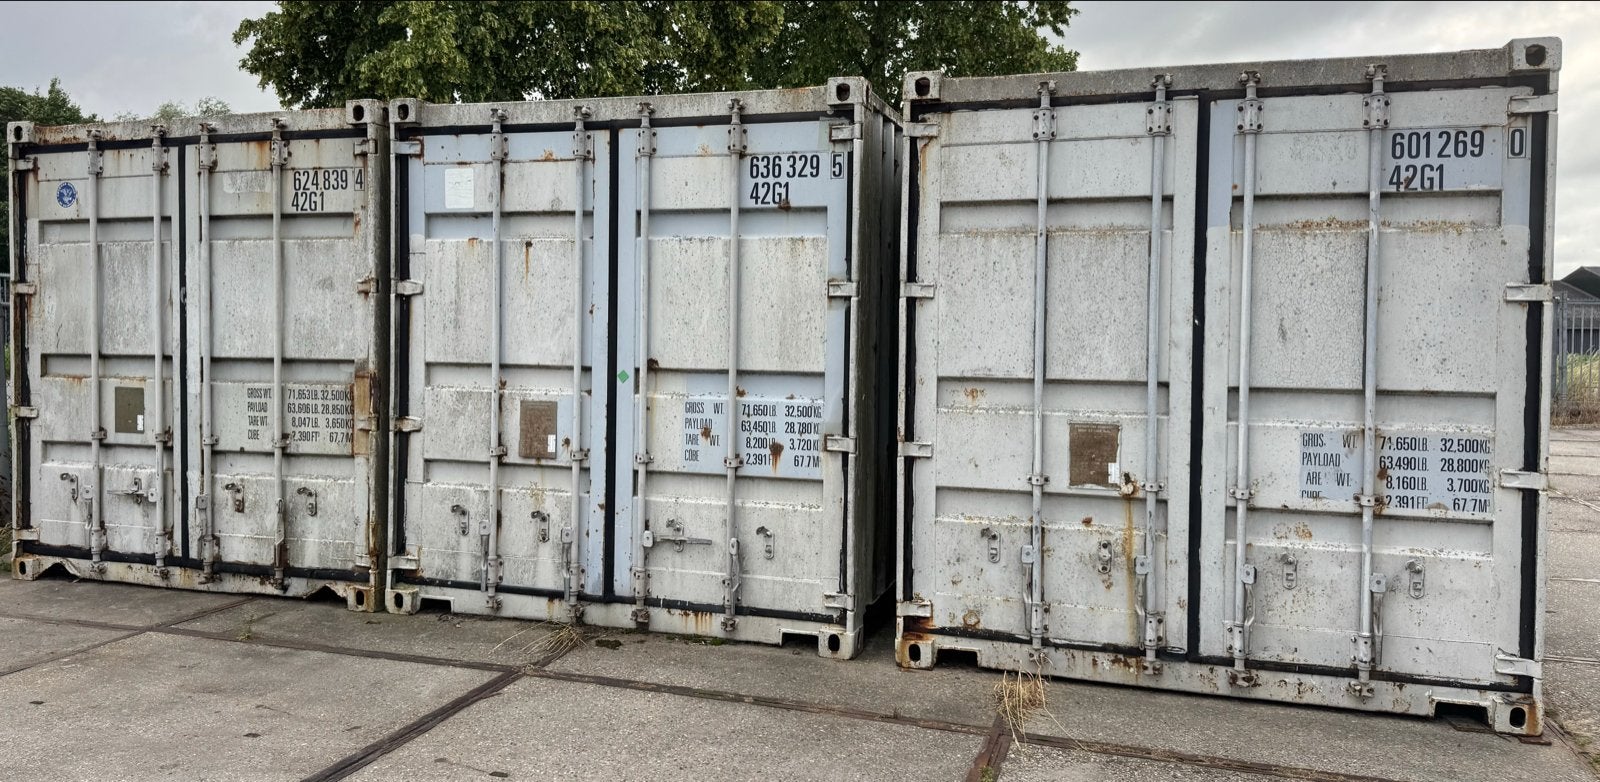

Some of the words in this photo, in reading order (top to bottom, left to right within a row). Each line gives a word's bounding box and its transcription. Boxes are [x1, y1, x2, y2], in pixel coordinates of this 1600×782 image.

[1510, 128, 1525, 157] 0
[750, 155, 782, 179] 636
[786, 154, 820, 178] 329
[832, 153, 843, 178] 5
[355, 168, 364, 190] 4
[1388, 163, 1445, 192] 42G1
[750, 181, 790, 205] 42G1
[291, 191, 325, 212] 42G1
[247, 401, 268, 413] PAYLOAD
[684, 401, 705, 415] GROSS
[248, 415, 260, 427] TARE
[684, 417, 713, 430] PAYLOAD
[247, 429, 260, 440] CUBE
[685, 433, 700, 446] TARE
[1302, 432, 1327, 448] GROS
[1302, 451, 1341, 467] PAYLOAD
[1305, 471, 1322, 486] ARE
